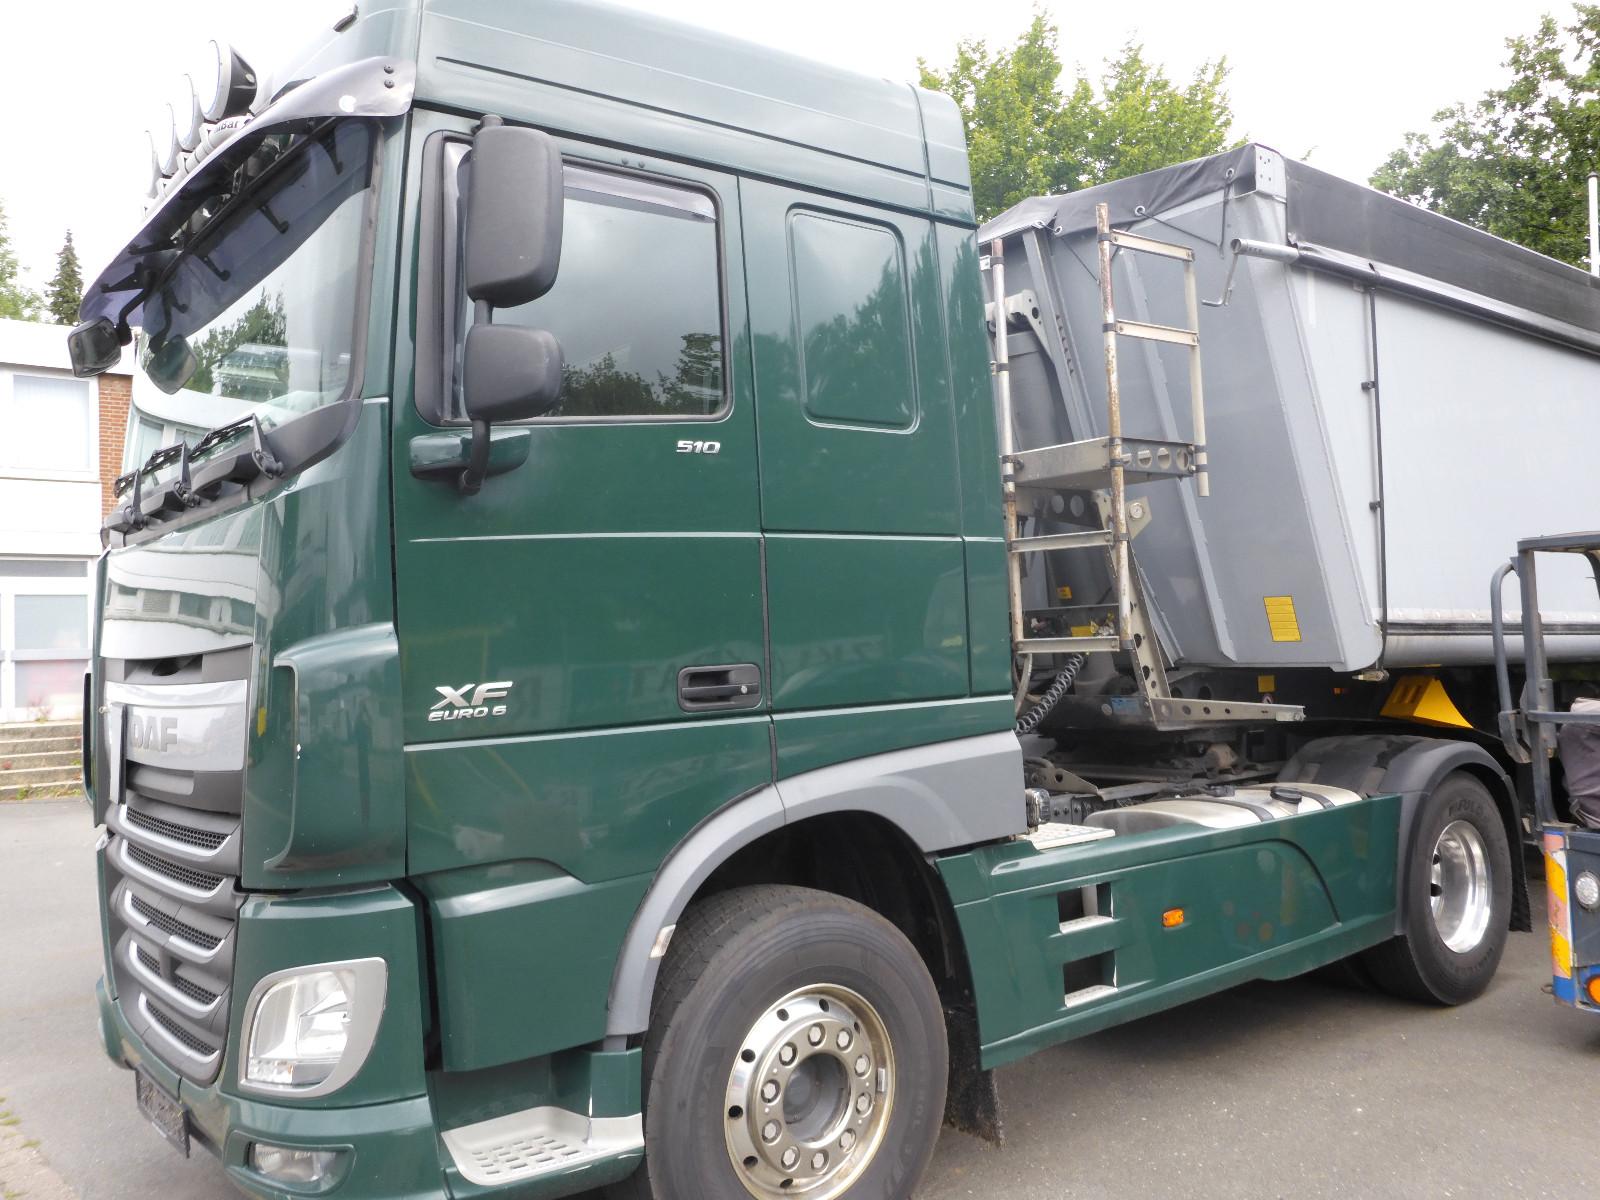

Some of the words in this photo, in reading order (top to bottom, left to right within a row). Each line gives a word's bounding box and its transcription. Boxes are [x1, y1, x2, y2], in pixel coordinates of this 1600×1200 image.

[676, 440, 721, 454] 510
[430, 681, 513, 710] XF
[428, 707, 489, 722] EURO
[492, 705, 507, 716] 6
[129, 714, 178, 752] DAF
